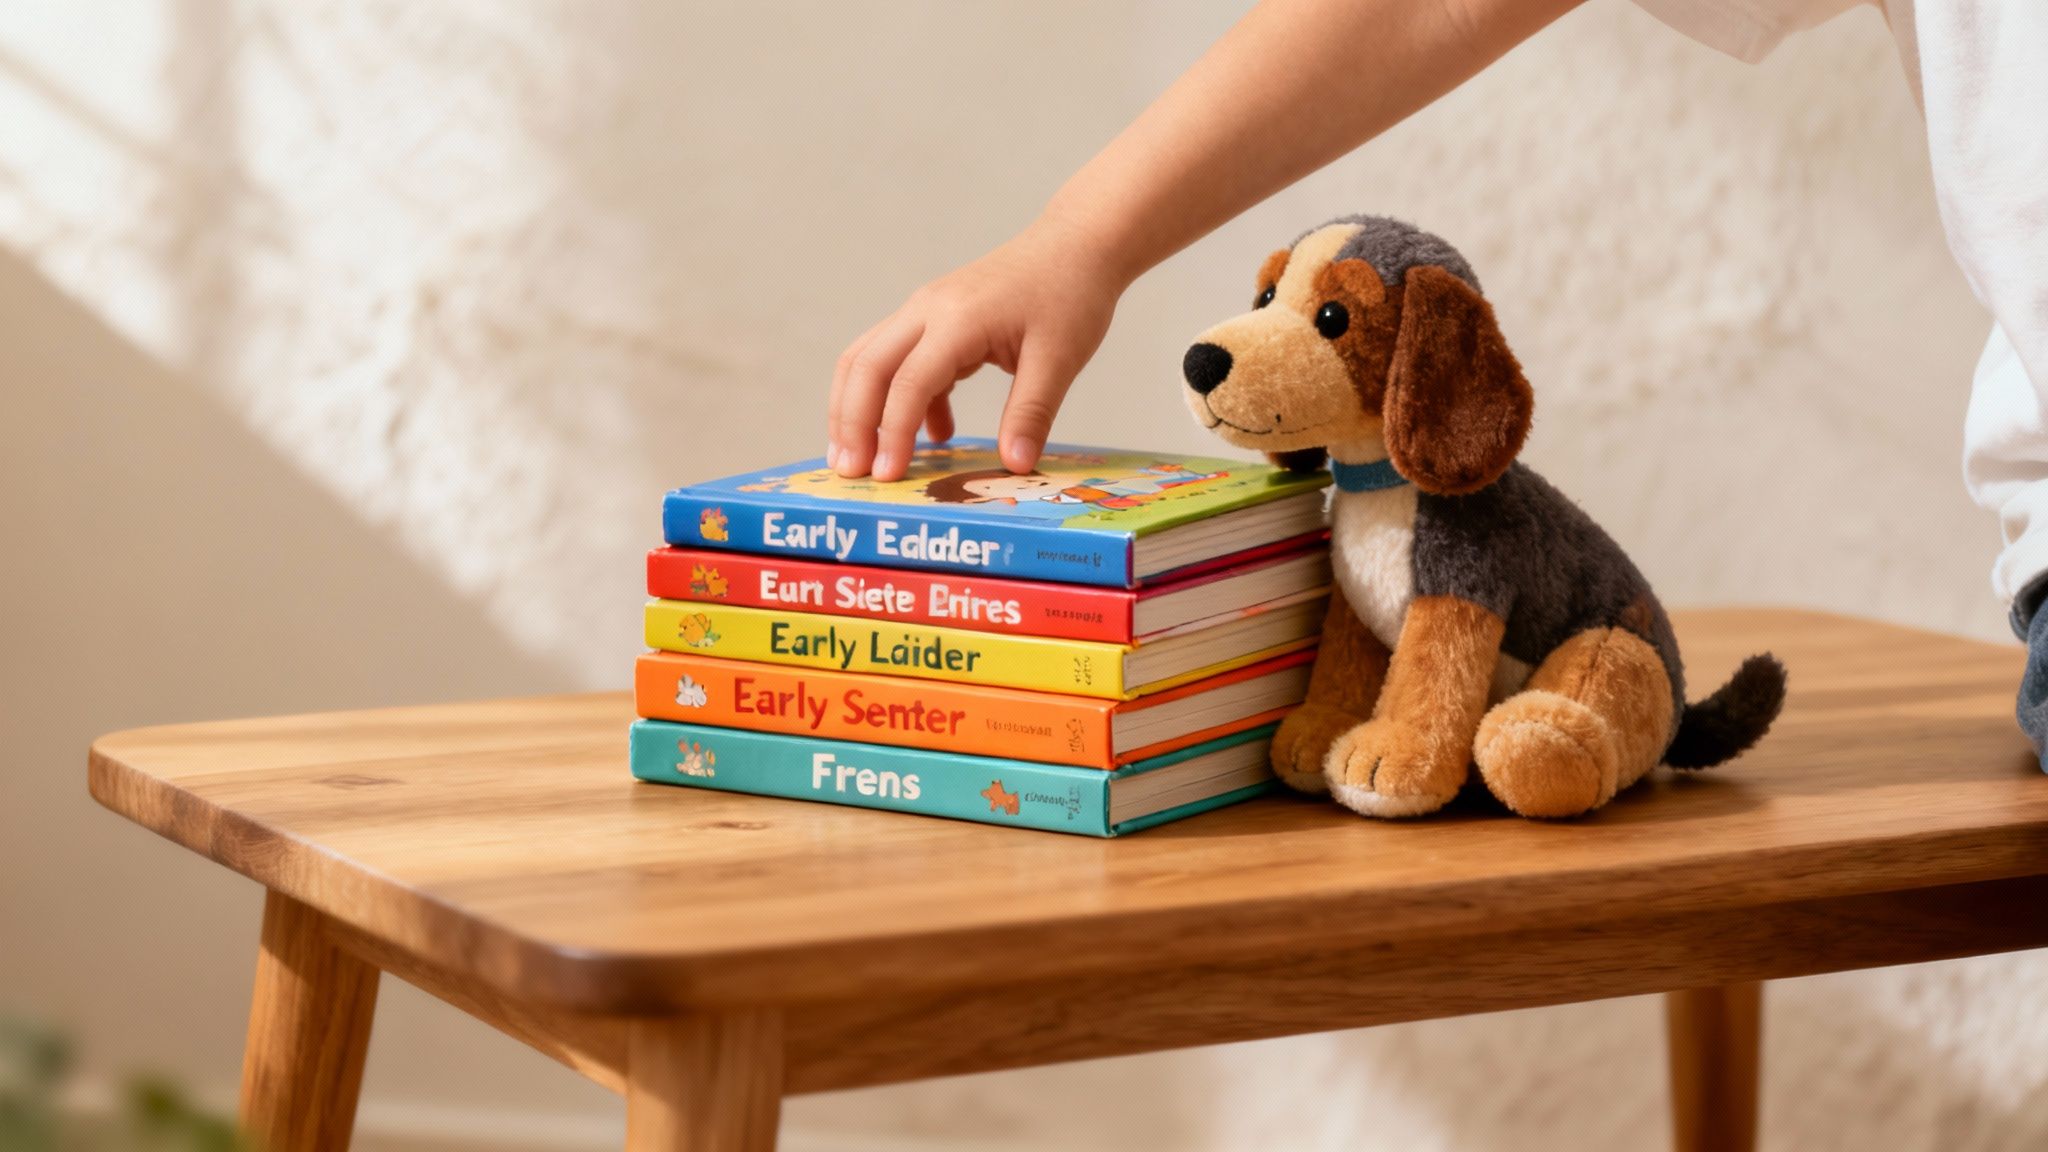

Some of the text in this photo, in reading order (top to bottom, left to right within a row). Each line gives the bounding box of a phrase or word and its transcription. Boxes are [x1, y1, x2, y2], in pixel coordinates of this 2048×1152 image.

[763, 512, 857, 559] Early
[771, 622, 856, 669] Early
[734, 677, 828, 730] Early
[812, 752, 920, 800] Frens
